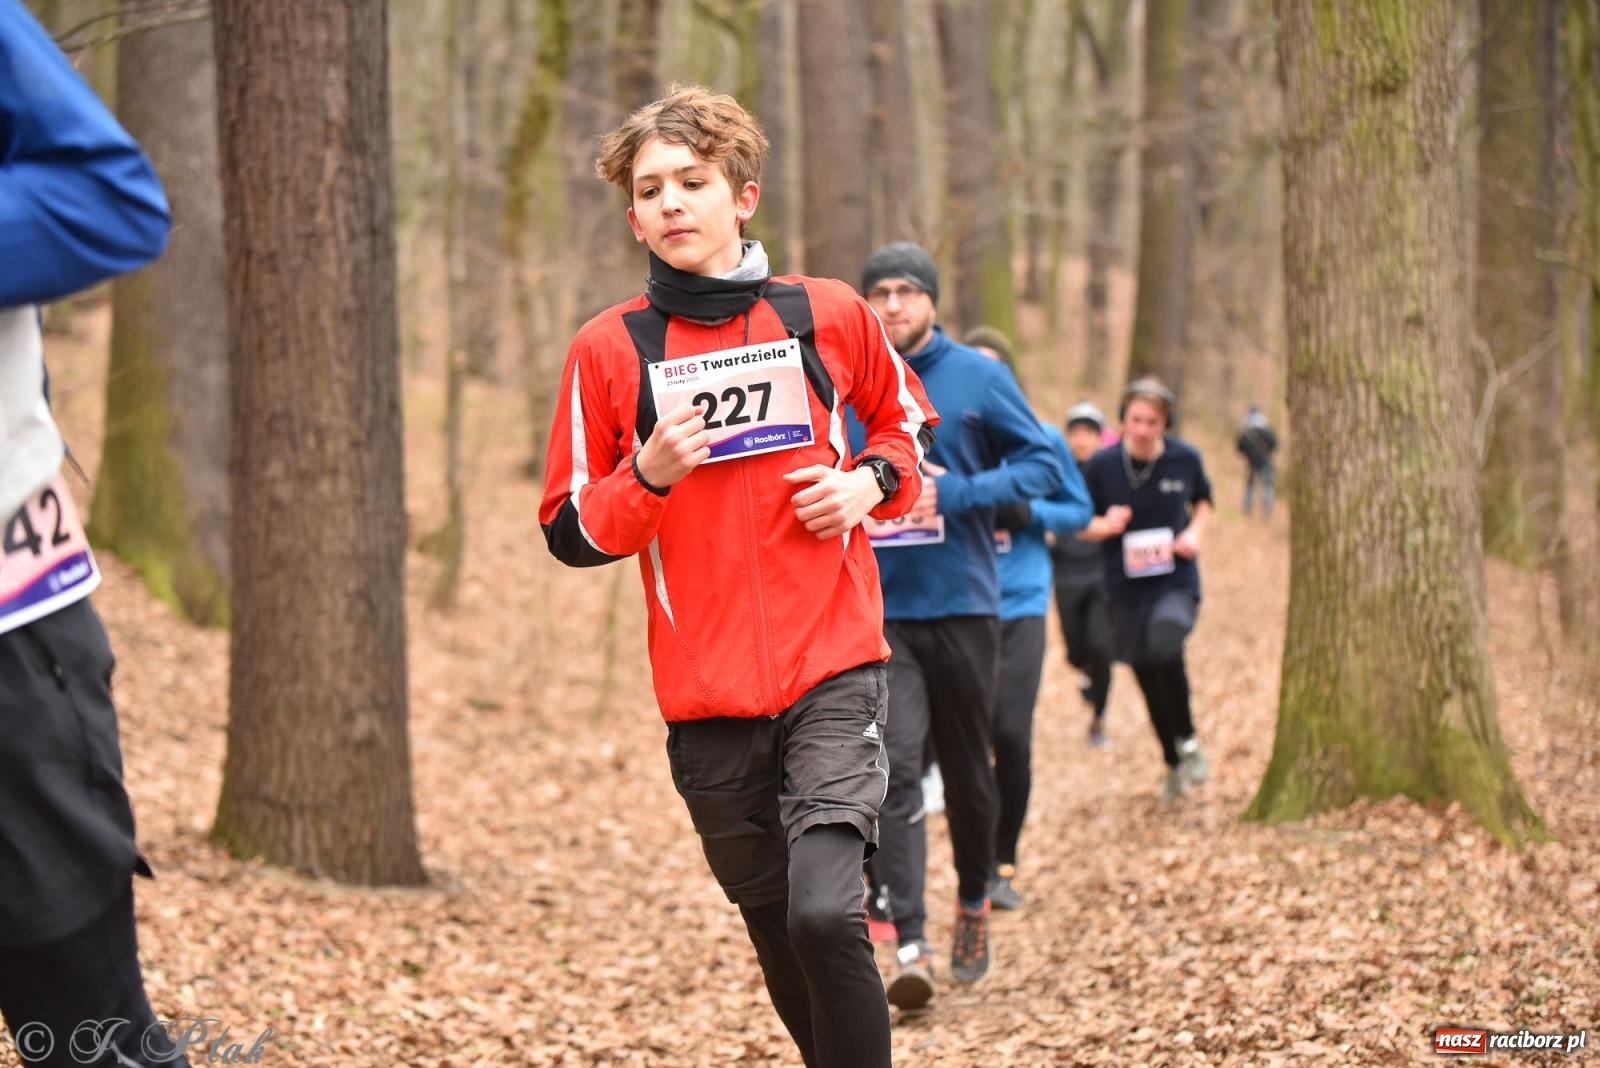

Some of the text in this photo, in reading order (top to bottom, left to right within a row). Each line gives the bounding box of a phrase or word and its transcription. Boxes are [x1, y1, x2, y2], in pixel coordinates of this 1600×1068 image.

[664, 348, 787, 378] BIEG Twardziela
[692, 381, 772, 430] 227
[0, 486, 71, 557] 42
